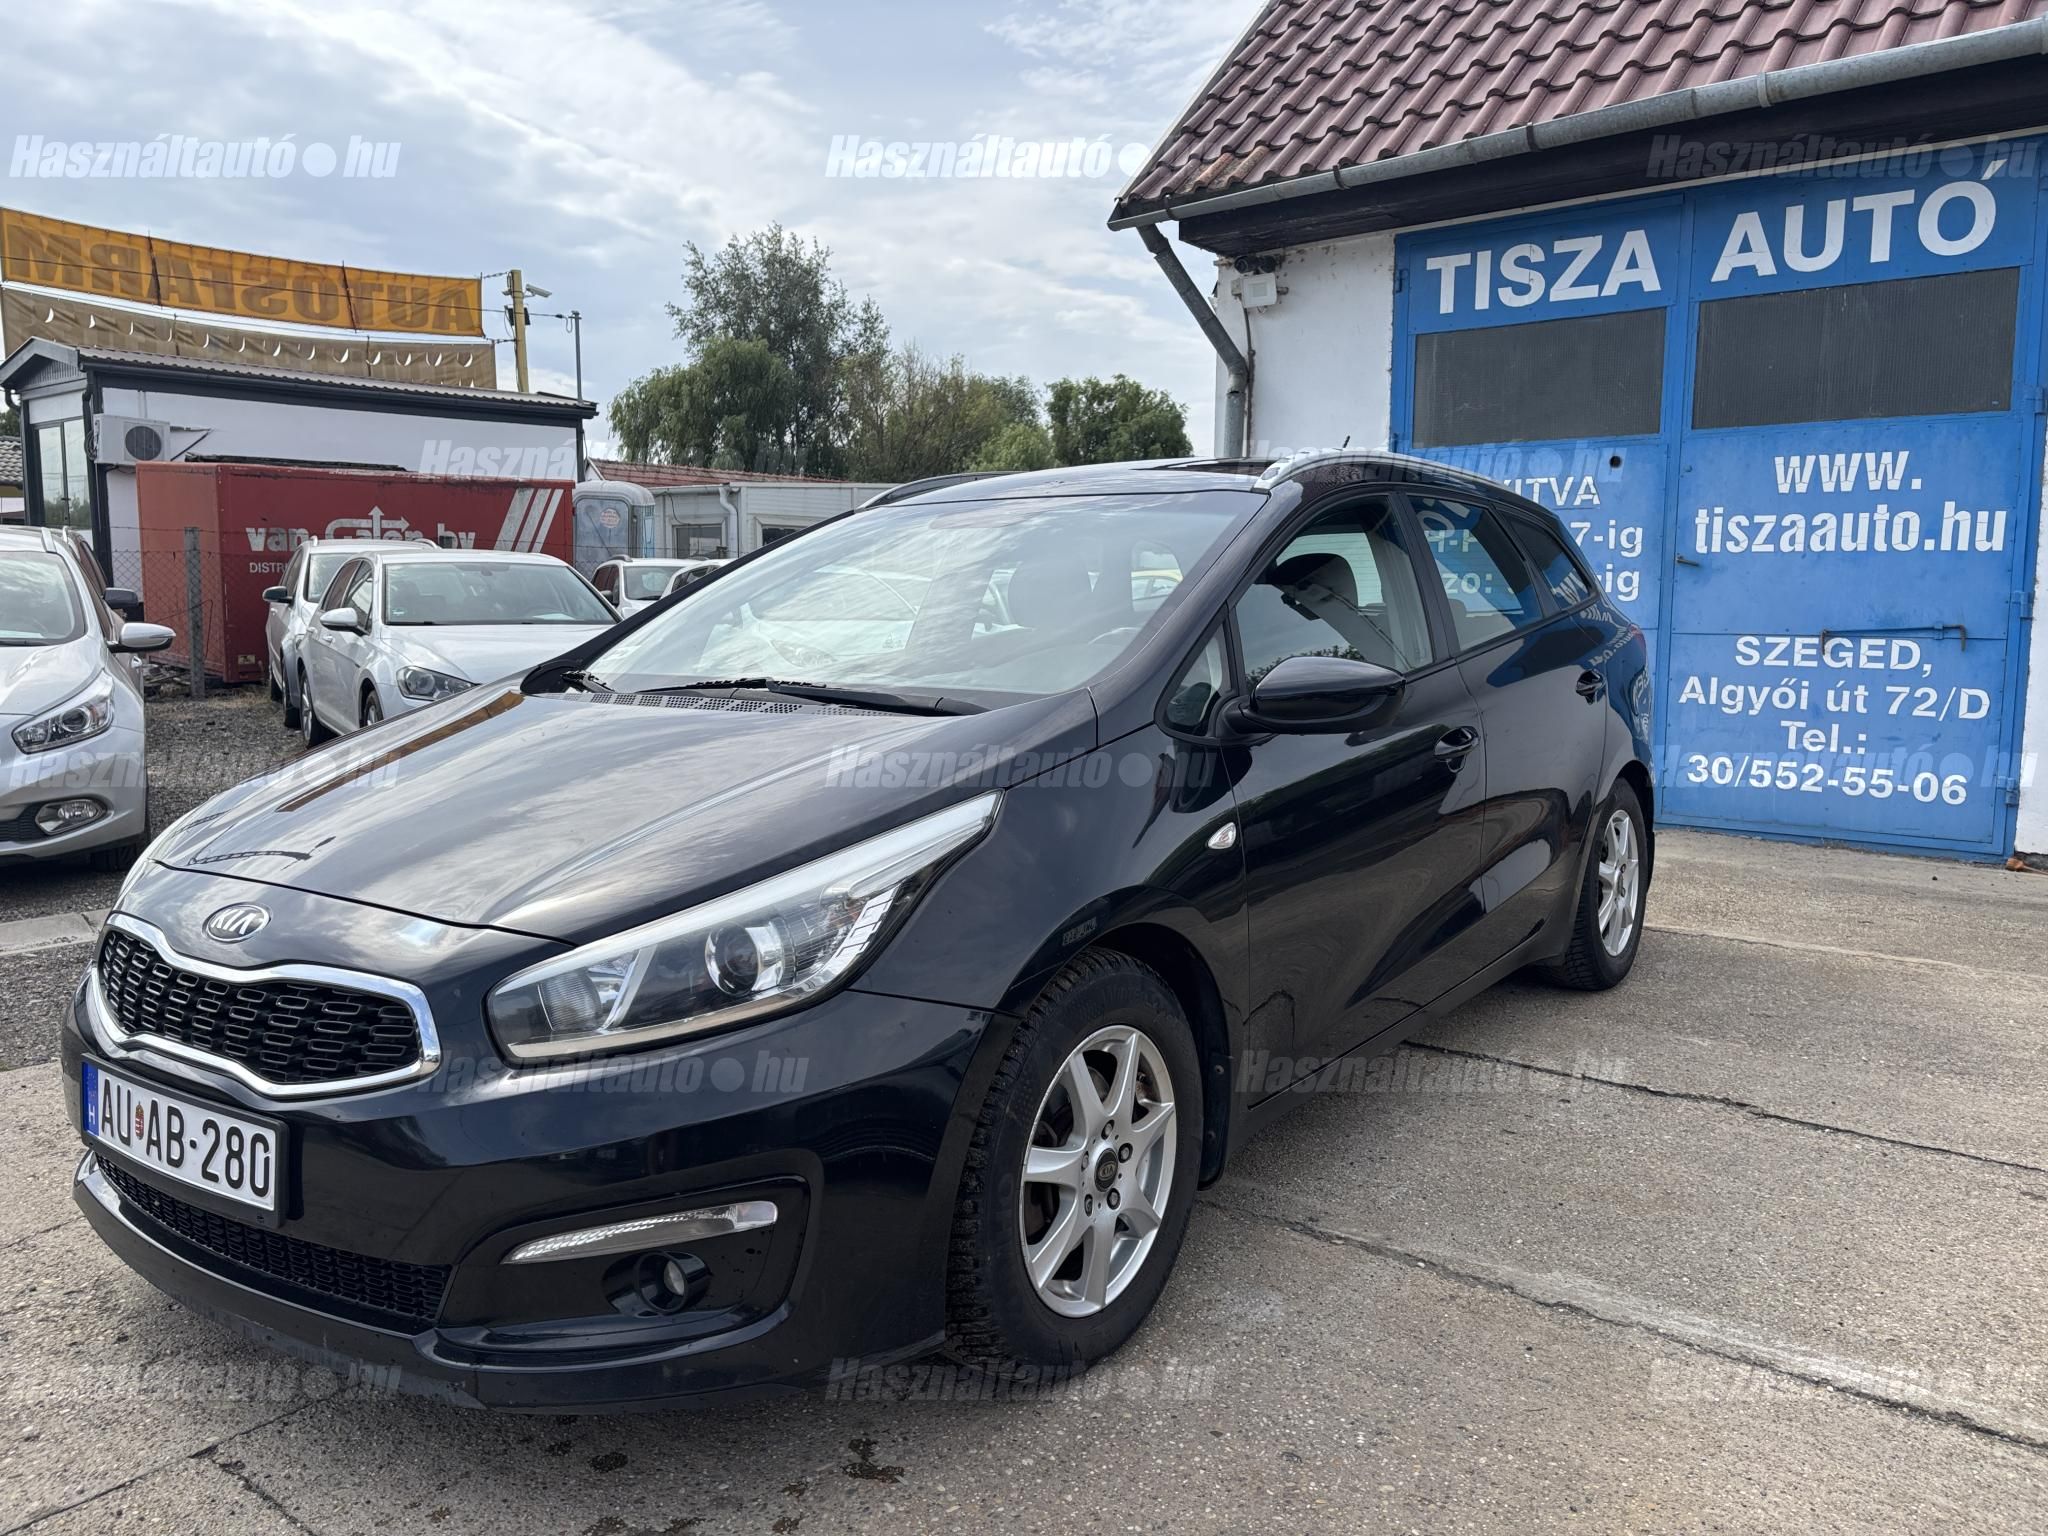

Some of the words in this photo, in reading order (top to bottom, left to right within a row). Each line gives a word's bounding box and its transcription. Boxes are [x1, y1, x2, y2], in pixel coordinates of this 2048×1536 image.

[1426, 229, 1662, 314] TISZA
[1710, 159, 2008, 284] AUTÓ
[1504, 476, 1601, 506] ITVA
[246, 527, 309, 552] van
[1696, 501, 2007, 555] tiszaauto.hu
[1735, 635, 1933, 678] SZEGED,
[1679, 676, 1809, 718] Algyői
[1826, 676, 1869, 714] út
[1885, 685, 1990, 722] 72/D
[1781, 720, 1867, 756] Tel.:
[1687, 754, 1968, 807] 30/552-55-06
[208, 911, 256, 934] KIA
[88, 1103, 96, 1126] H
[101, 1078, 132, 1147] AU
